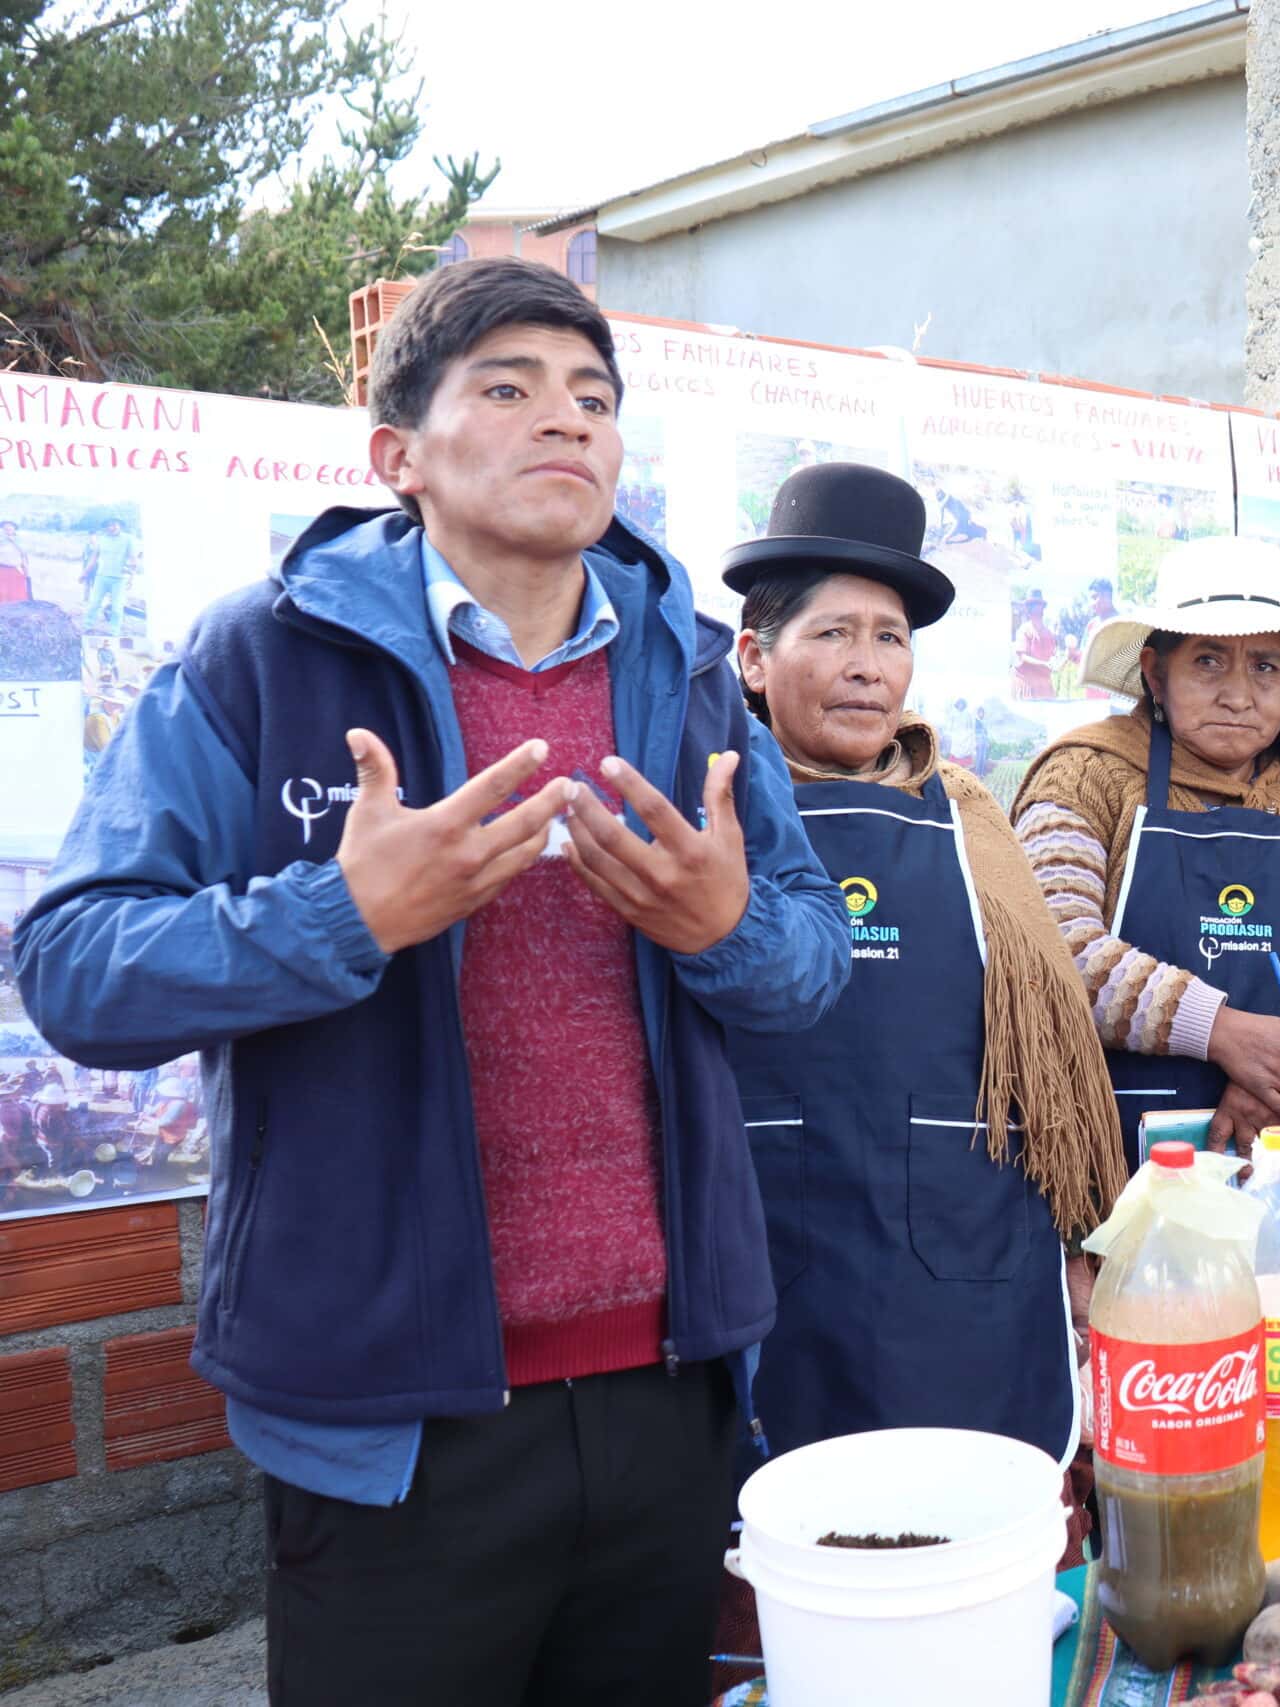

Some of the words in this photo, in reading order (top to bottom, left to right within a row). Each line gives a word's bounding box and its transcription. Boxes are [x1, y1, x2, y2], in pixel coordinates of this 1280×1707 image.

[663, 340, 818, 378] FAMILIARES
[952, 384, 1054, 416] HUERTOS
[1200, 923, 1272, 937] PRODIASUR
[886, 947, 900, 959] 21
[1221, 940, 1260, 952] mission
[1261, 942, 1272, 952] 21
[1119, 1343, 1260, 1414] Coca-Cola
[1151, 1418, 1194, 1430] SABOR
[1196, 1410, 1245, 1429] ORIGINAL
